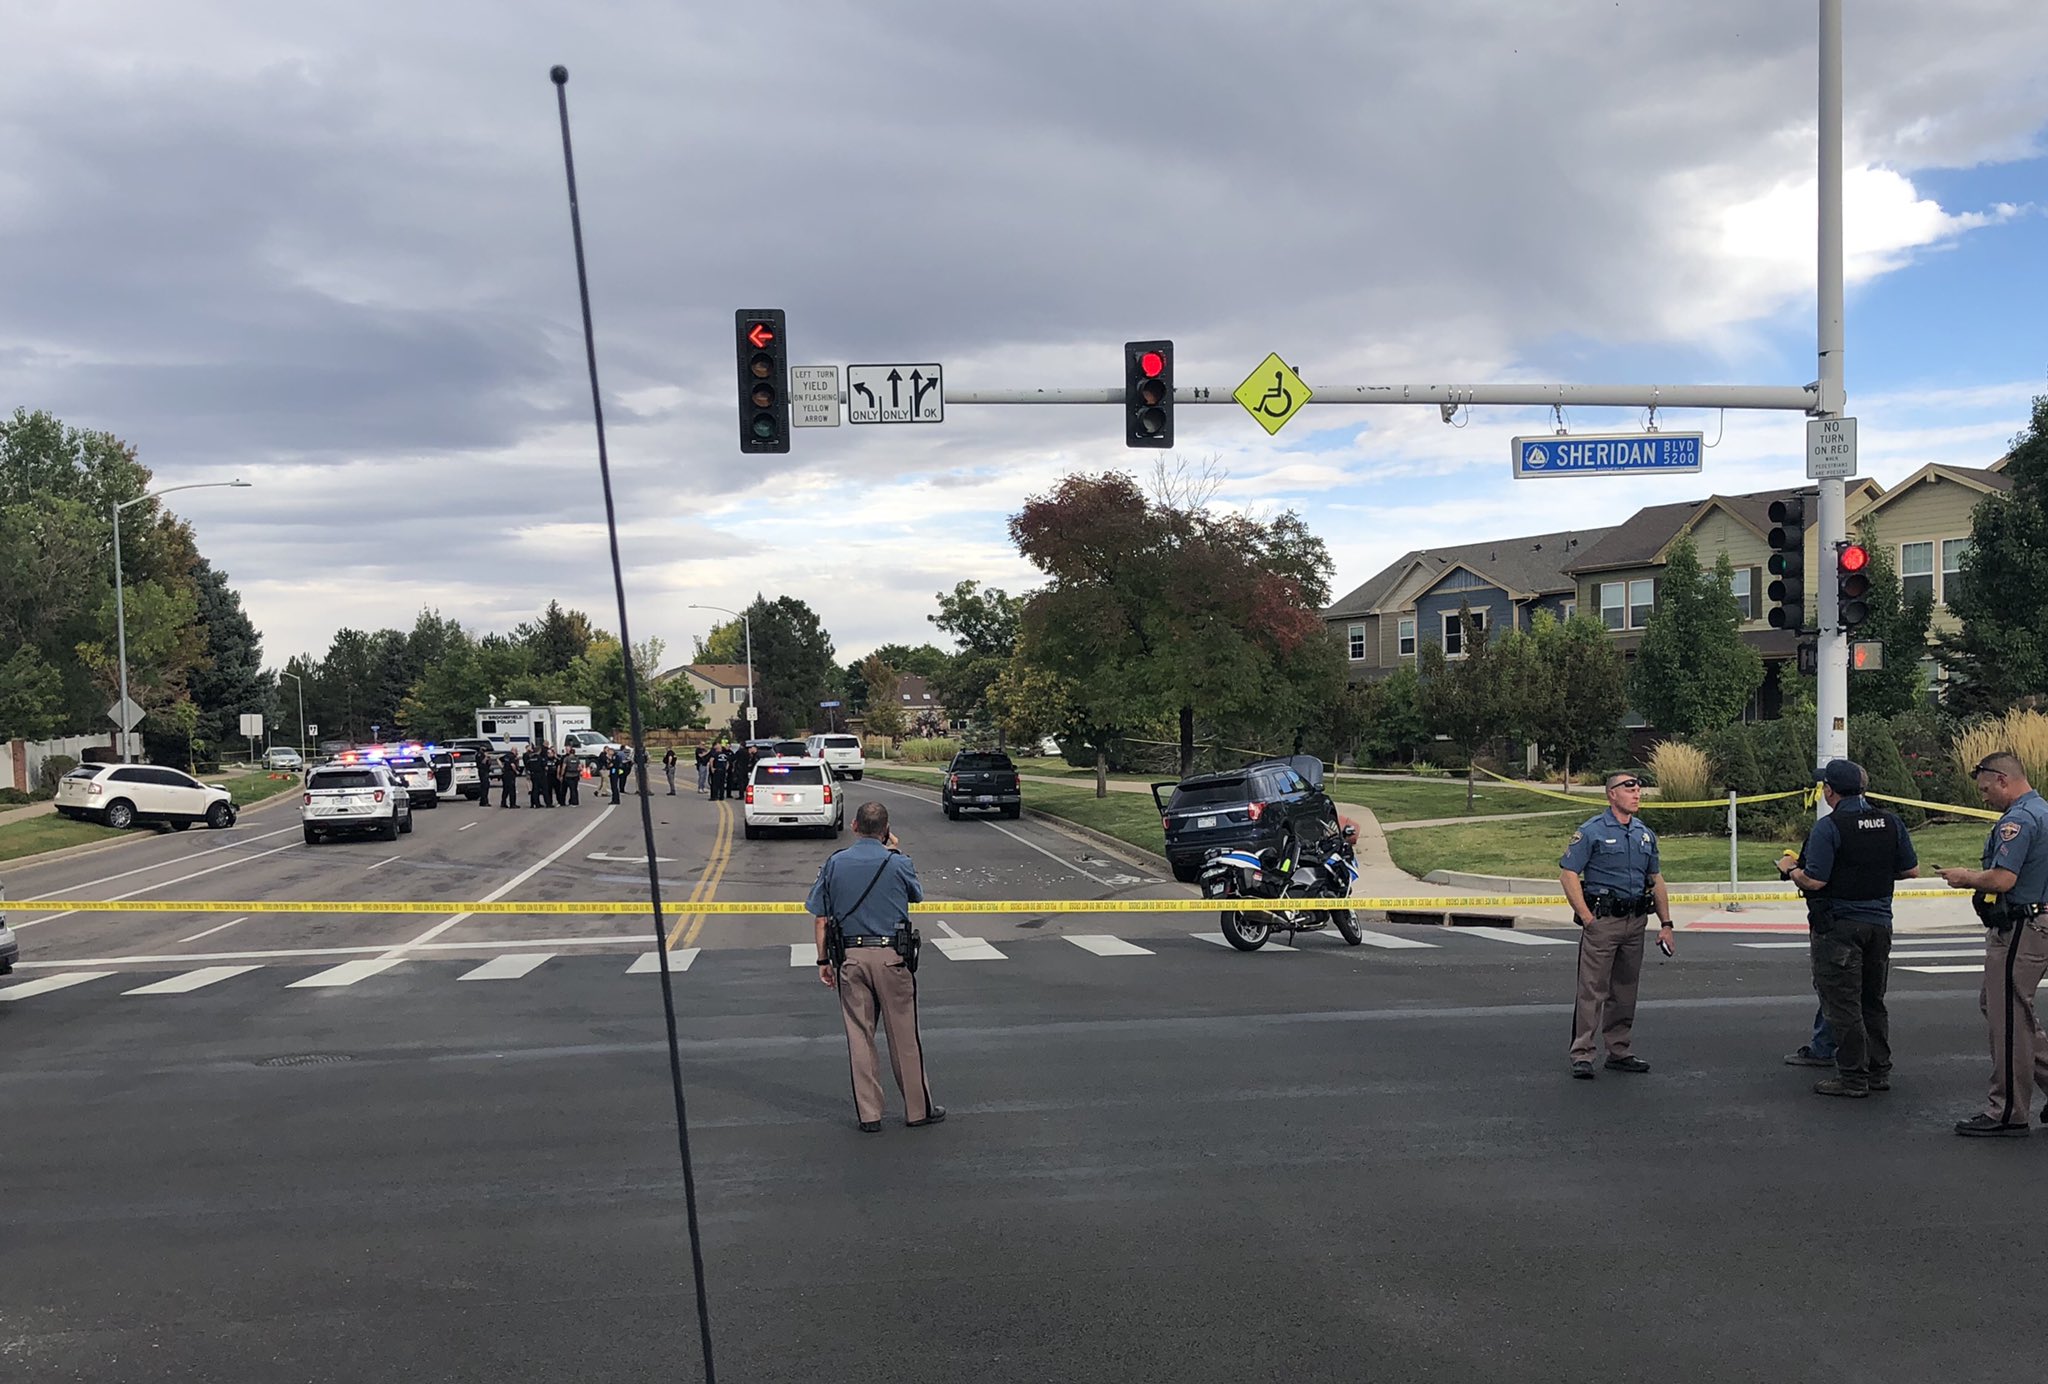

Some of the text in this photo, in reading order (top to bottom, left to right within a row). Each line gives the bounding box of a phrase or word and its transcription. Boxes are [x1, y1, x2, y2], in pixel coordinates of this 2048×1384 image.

[802, 381, 828, 390] YIELD
[852, 408, 937, 420] ONLY ONLY OK
[1824, 422, 1839, 432] NO
[1820, 434, 1844, 443] TURN
[1663, 440, 1694, 452] BLVD
[1814, 445, 1849, 455] ON RED
[1556, 442, 1656, 467] SHERIDAN
[1663, 453, 1695, 465] 5200
[1858, 818, 1886, 829] POLICE
